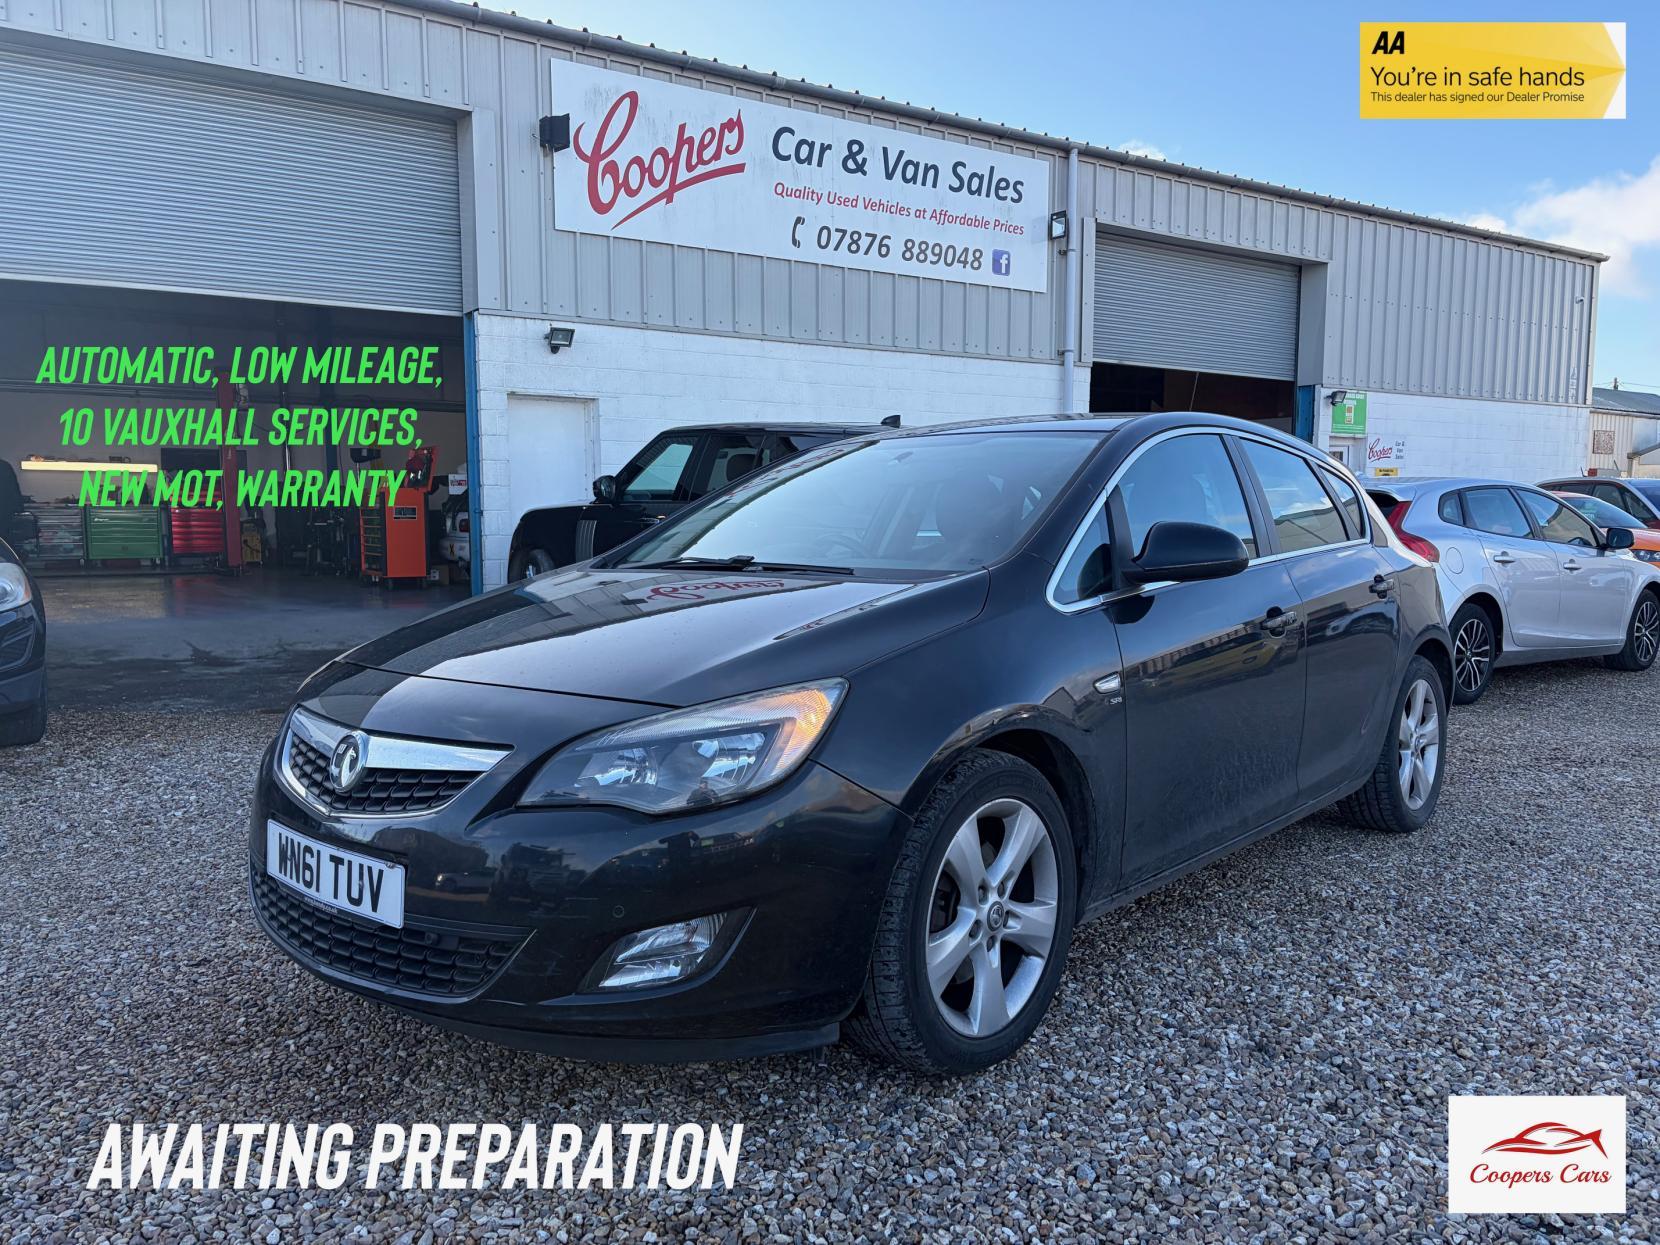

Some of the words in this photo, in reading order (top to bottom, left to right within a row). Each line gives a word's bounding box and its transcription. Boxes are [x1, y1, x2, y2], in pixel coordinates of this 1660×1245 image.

[573, 90, 746, 218] Coopers
[771, 126, 832, 168] Car
[841, 139, 868, 177] &
[881, 146, 940, 189] Van
[948, 160, 1025, 204] Sales
[773, 182, 823, 206] Quality
[826, 190, 859, 209] Used
[862, 194, 911, 218] Vehicles
[914, 204, 928, 220] at
[929, 206, 990, 231] Affordable
[993, 214, 1025, 237] Prices
[816, 224, 892, 259] 07876
[901, 238, 984, 271] 889048
[278, 831, 321, 893] WN61
[329, 854, 384, 913] TUV
